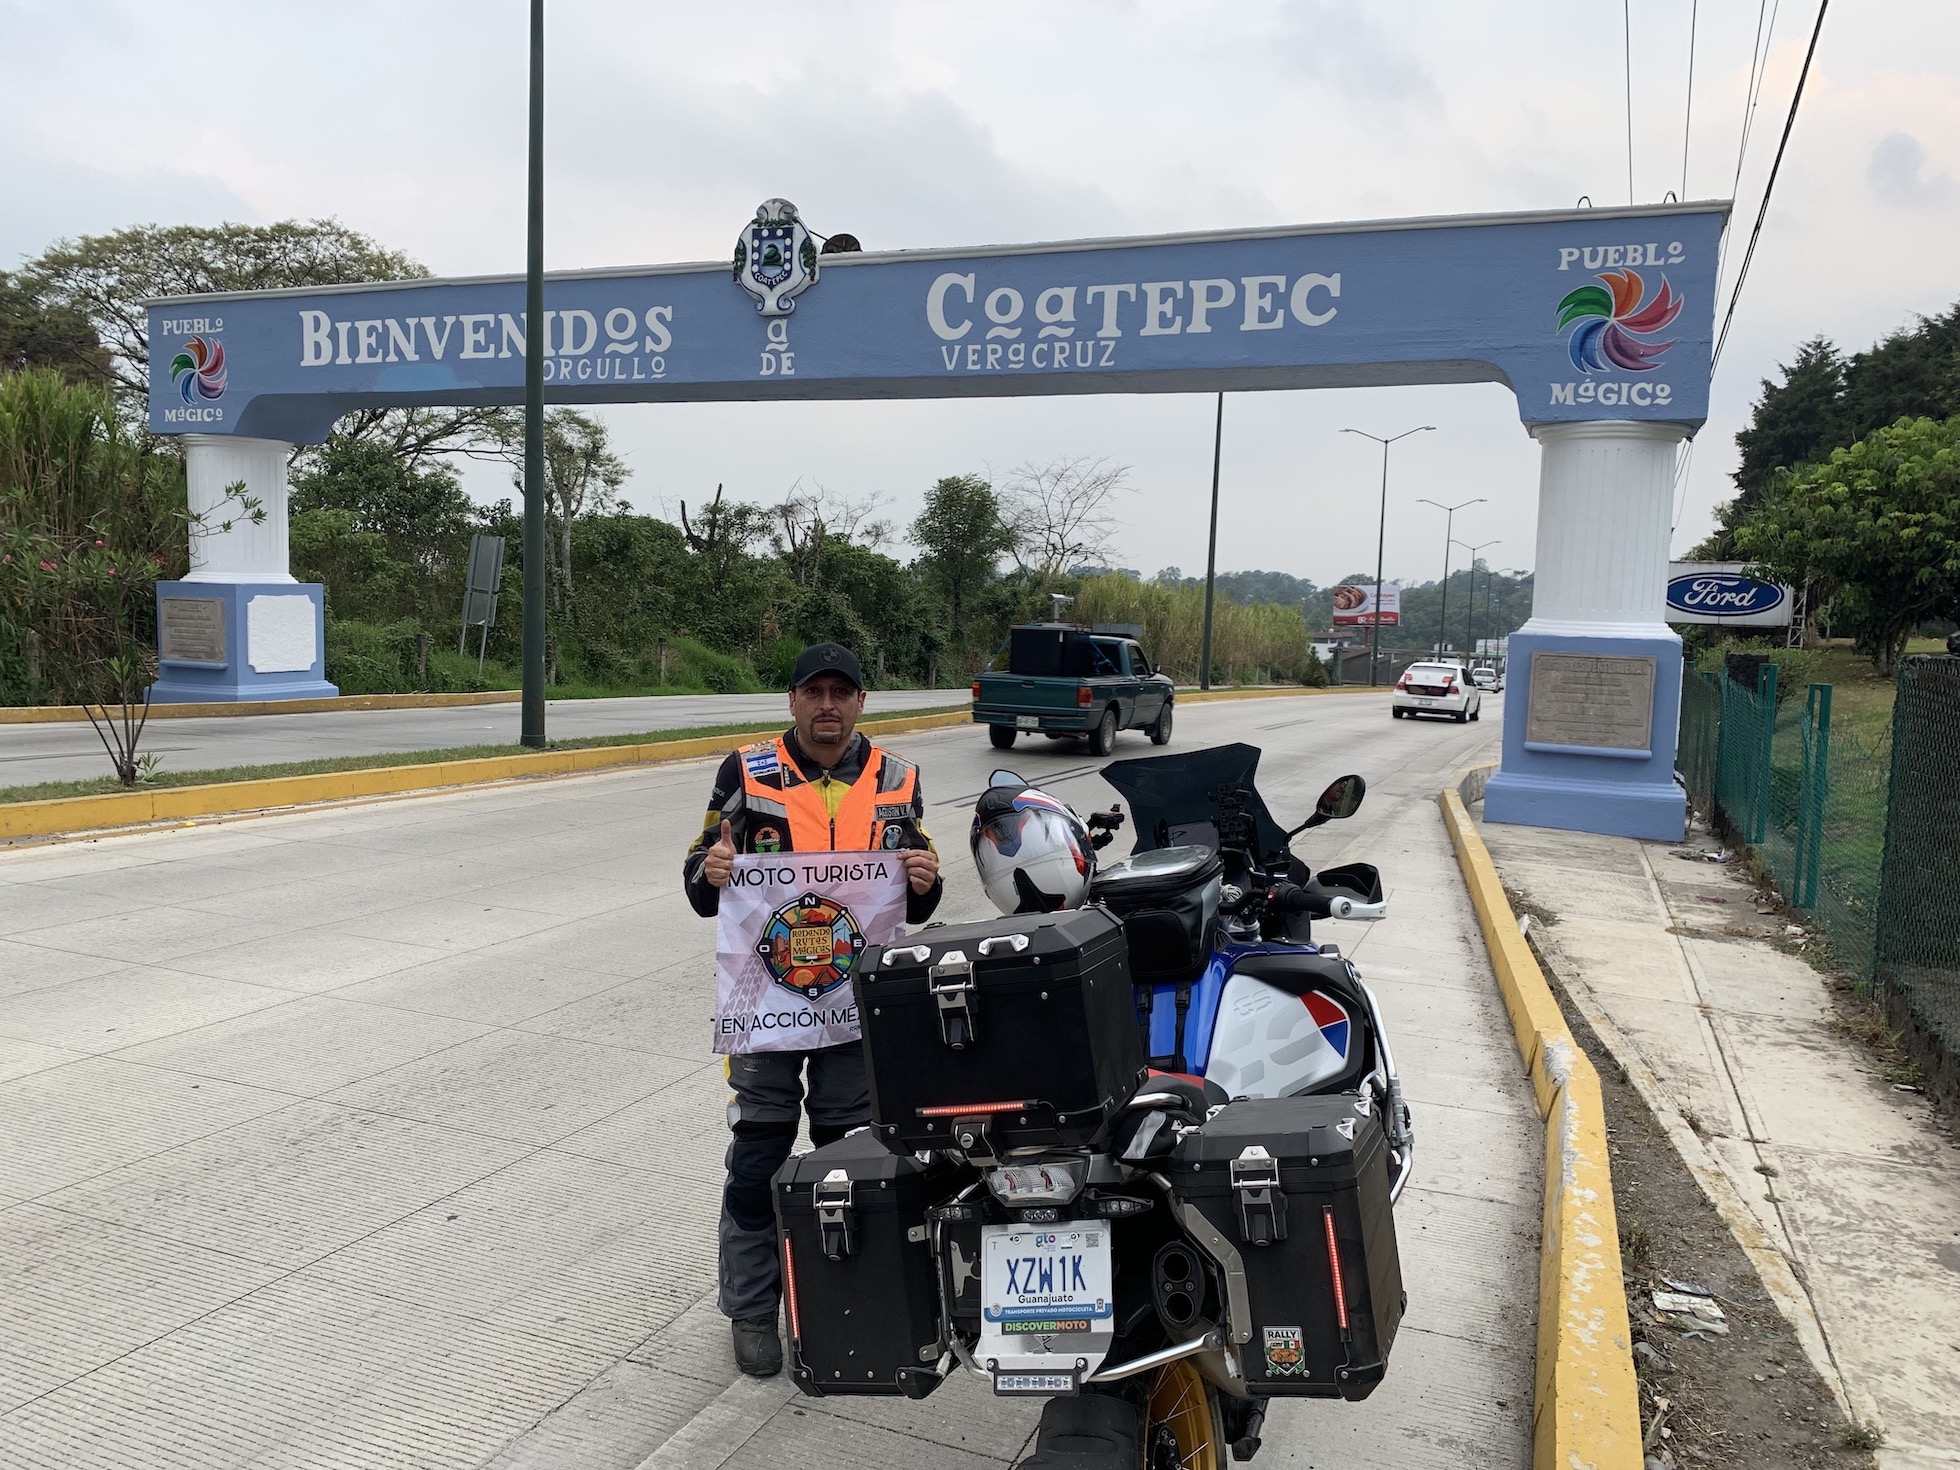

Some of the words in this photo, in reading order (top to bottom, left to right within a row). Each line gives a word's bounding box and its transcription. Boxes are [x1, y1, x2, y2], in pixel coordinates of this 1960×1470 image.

[1557, 241, 1686, 271] PUEBLO
[754, 270, 788, 286] COATEPEC
[162, 318, 224, 336] PUEBLO
[299, 305, 672, 367] BIENVENIDOS
[759, 352, 795, 376] DE
[1684, 578, 1758, 607] Ford
[728, 867, 796, 888] MOTO
[802, 862, 888, 884] TURISTA
[804, 896, 816, 906] N
[759, 945, 771, 953] O
[853, 938, 863, 947] E
[808, 987, 818, 997] S
[1233, 989, 1273, 1016] GS
[721, 1017, 746, 1034] EN
[751, 1007, 826, 1032] ACCIÓN
[831, 1003, 861, 1025] MÉ
[992, 1241, 998, 1250] T
[1035, 1233, 1056, 1248] gto
[1006, 1254, 1087, 1295] XZW1K
[1018, 1294, 1074, 1306] Guanajuato
[1005, 1307, 1035, 1315] TRANSPORTE
[1267, 1330, 1297, 1339] RALLY
